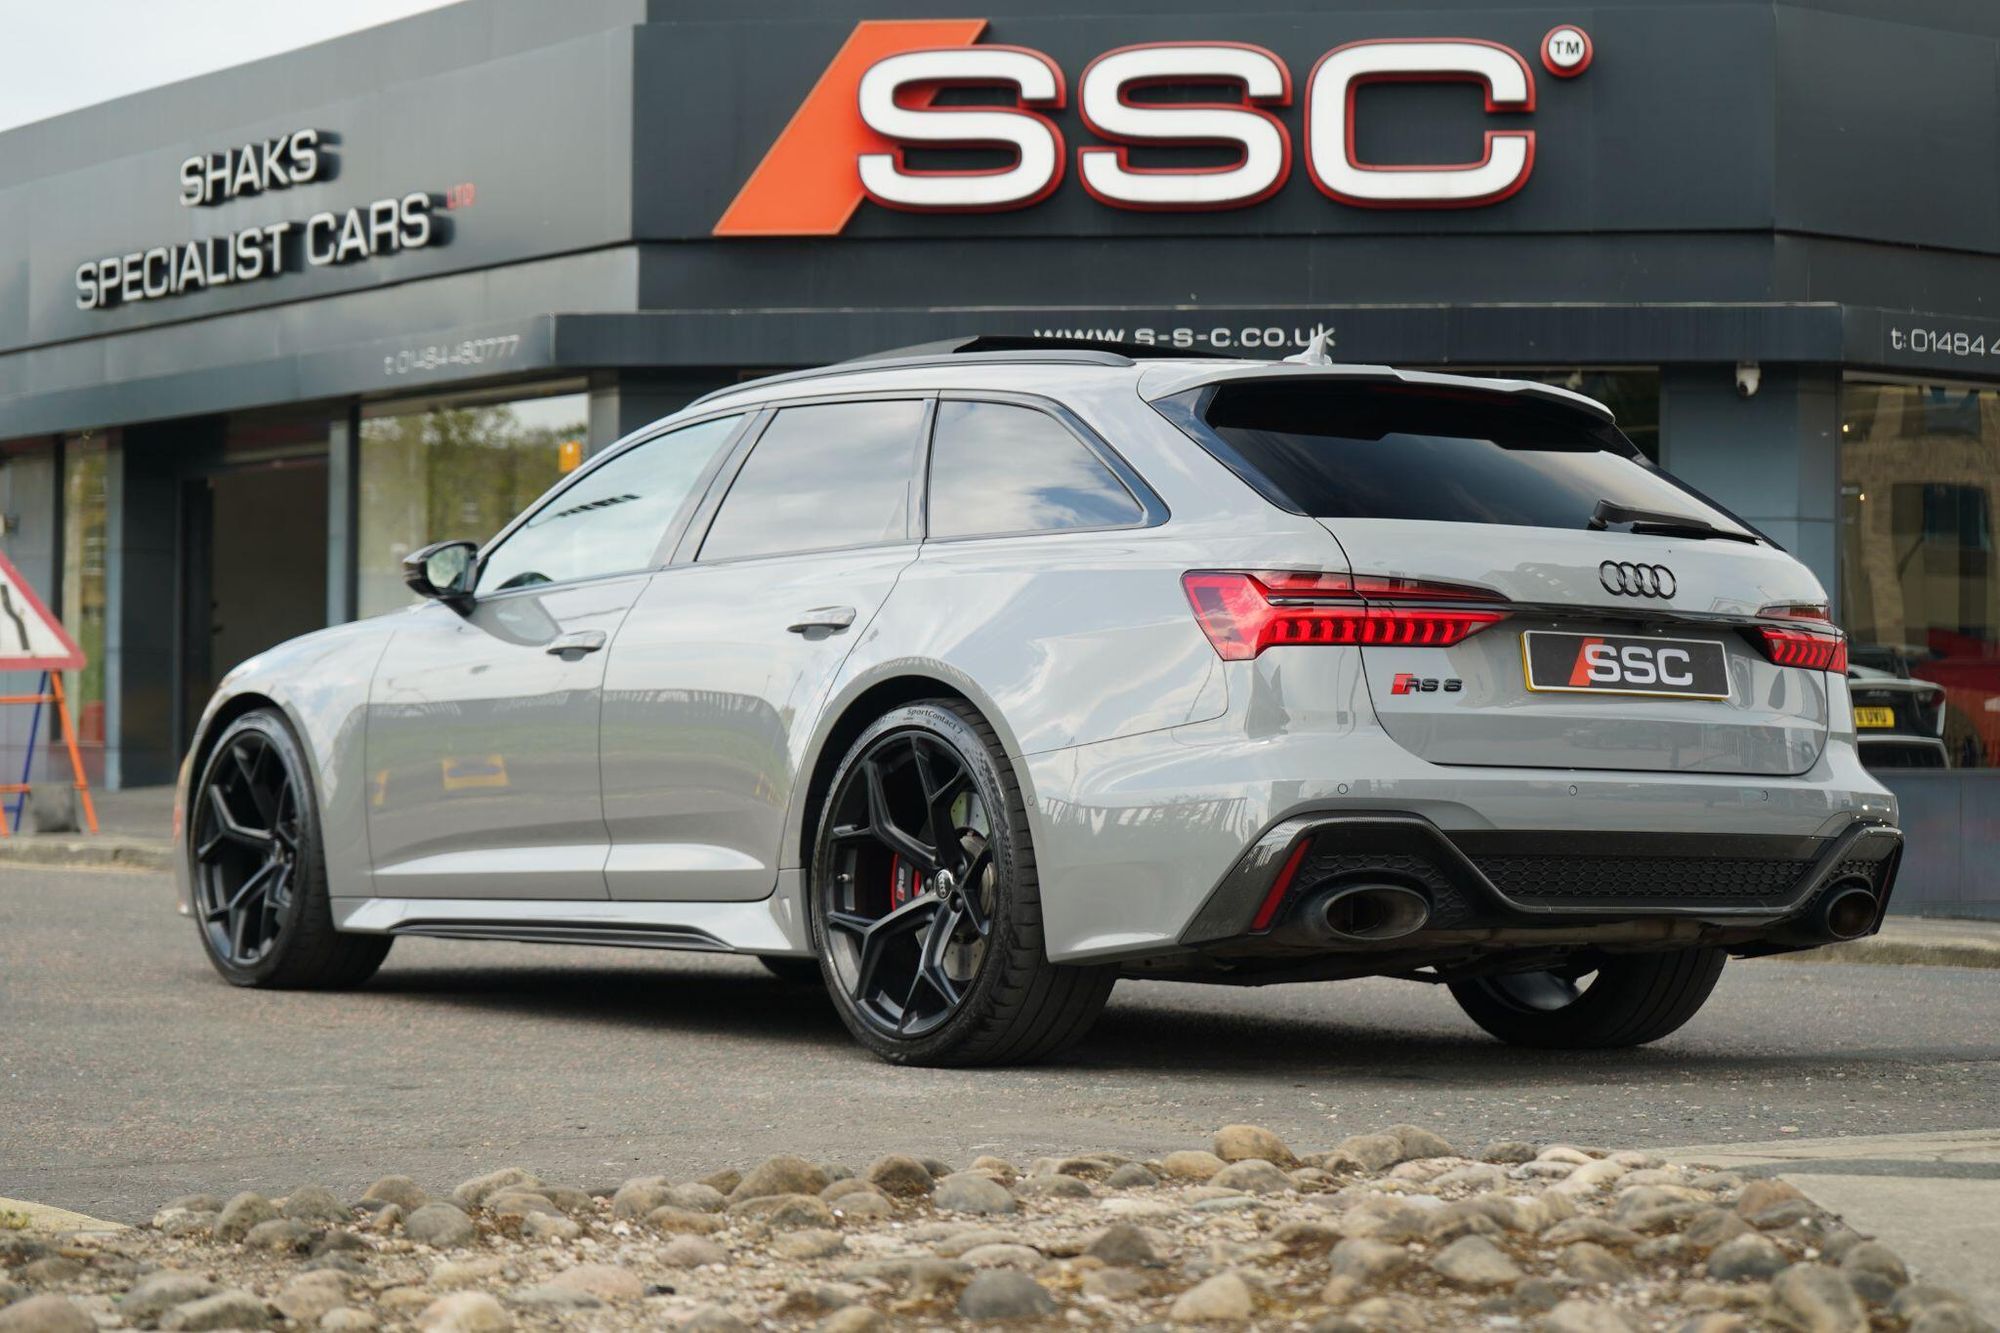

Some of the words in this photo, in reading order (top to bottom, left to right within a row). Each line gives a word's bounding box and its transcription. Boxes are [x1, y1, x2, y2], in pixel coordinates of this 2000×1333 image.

[1554, 40, 1580, 55] TM
[857, 40, 1533, 211] SSC
[180, 129, 318, 207] SHAKS
[76, 221, 290, 309] SPECIALIST
[306, 193, 431, 266] CARS
[1403, 678, 1440, 692] RS
[1443, 678, 1463, 692] 6
[1584, 644, 1693, 687] SSC
[907, 708, 957, 730] SportContact
